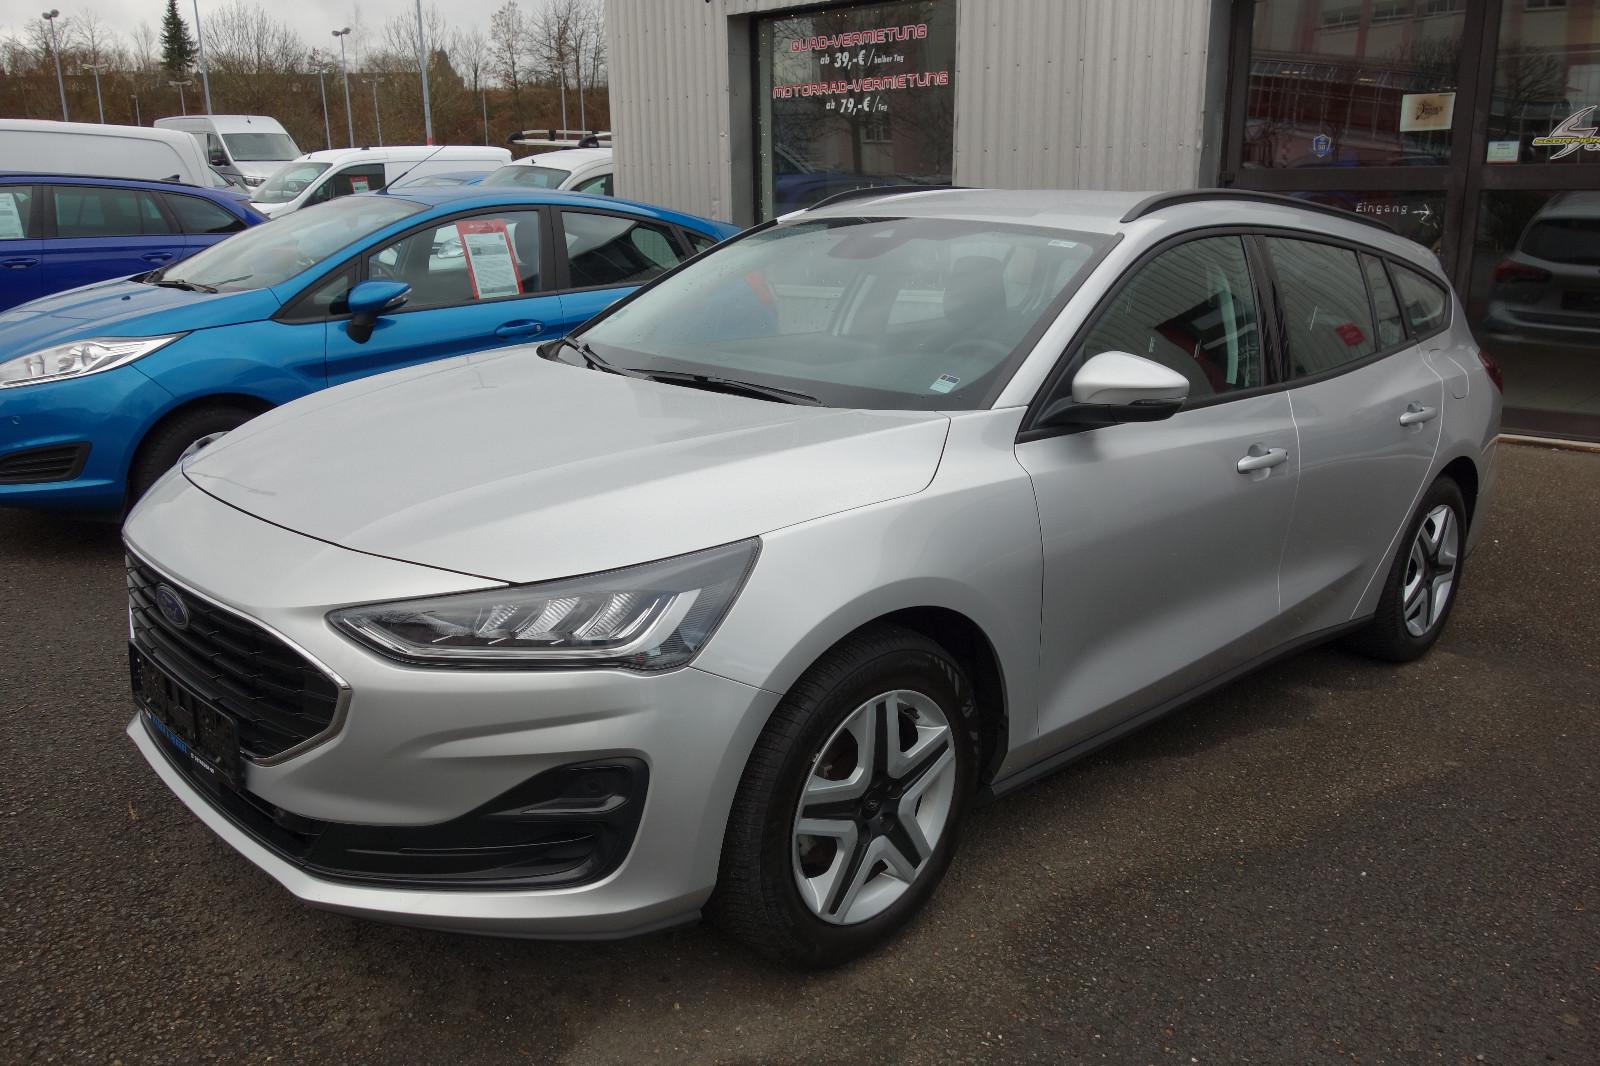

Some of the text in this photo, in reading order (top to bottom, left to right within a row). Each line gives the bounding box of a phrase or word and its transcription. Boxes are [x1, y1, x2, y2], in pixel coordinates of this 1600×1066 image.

[791, 23, 928, 52] QUAD-VERMIETUNG
[820, 53, 830, 65] ab
[772, 71, 949, 99] MOTORRAD-VERMIETUNG
[825, 99, 836, 111] ab
[1355, 202, 1408, 215] Eingang
